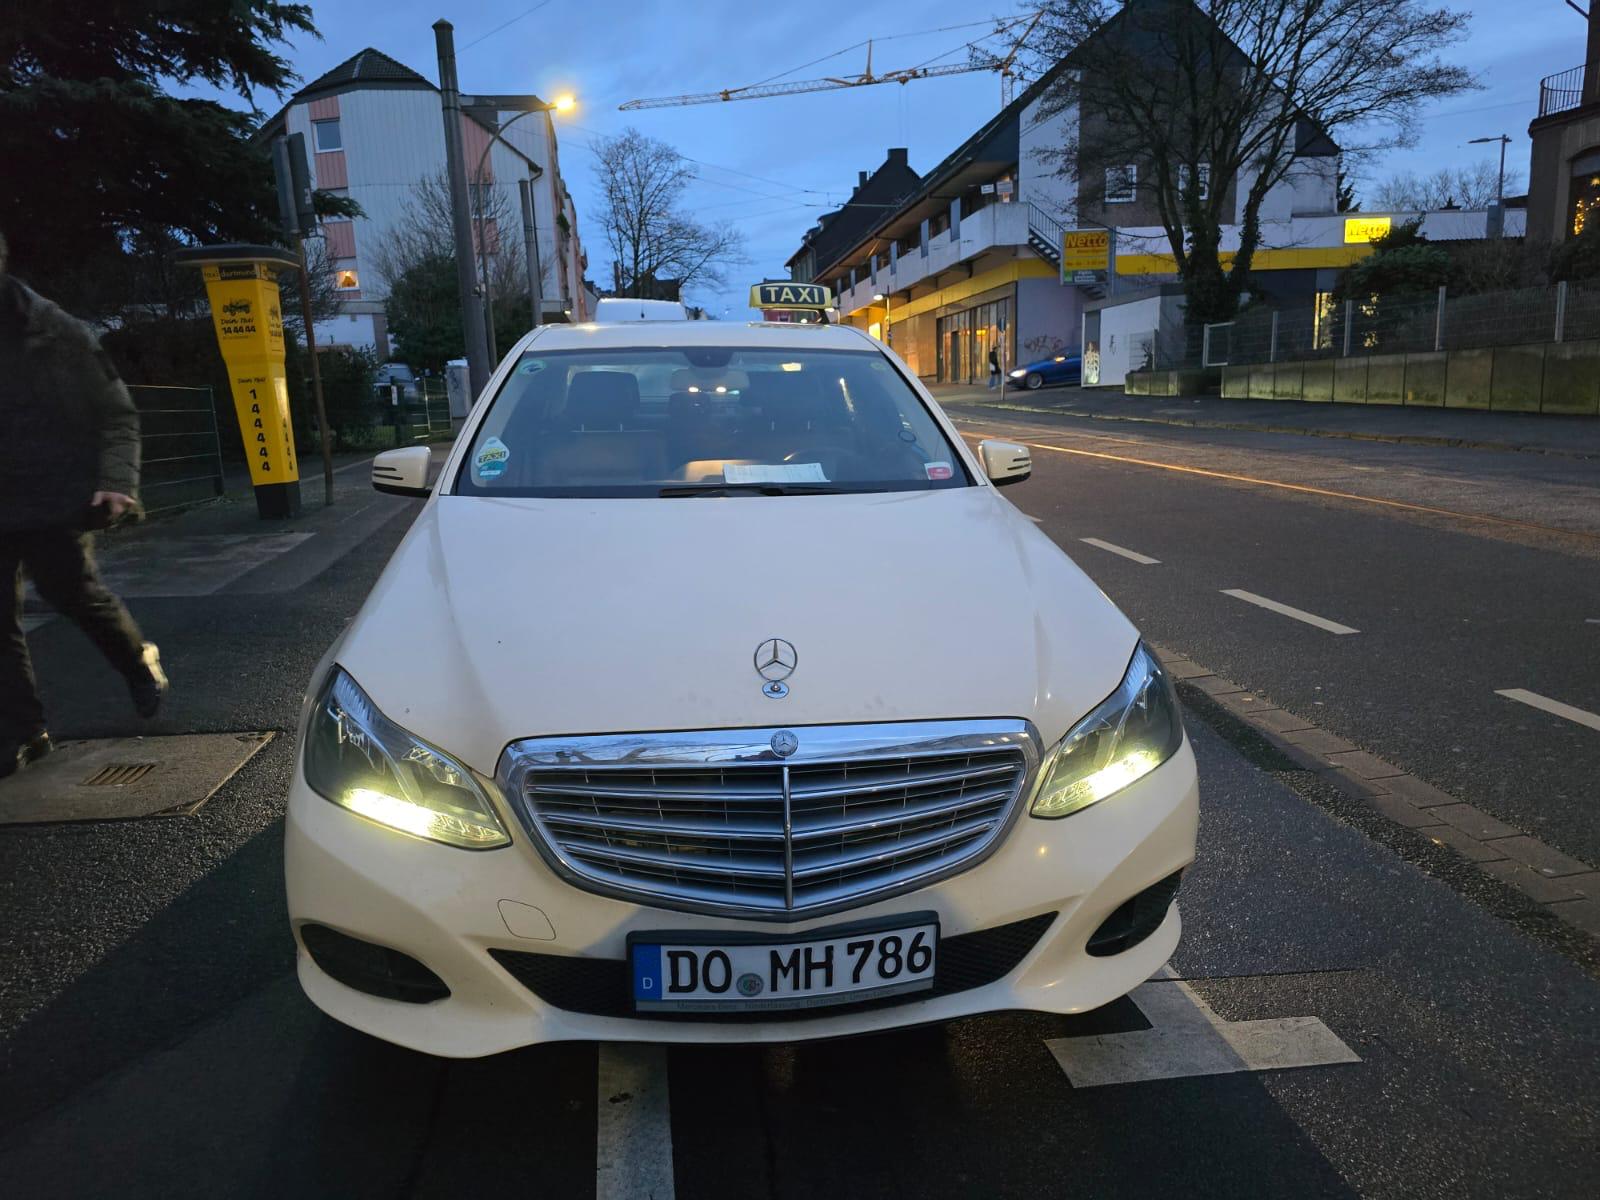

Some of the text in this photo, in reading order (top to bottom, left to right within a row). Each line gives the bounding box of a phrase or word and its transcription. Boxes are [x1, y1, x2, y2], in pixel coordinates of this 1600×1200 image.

[1066, 232, 1108, 248] Netto
[765, 287, 819, 303] TAXI
[667, 931, 932, 993] DO MH 786
[642, 978, 653, 990] D
